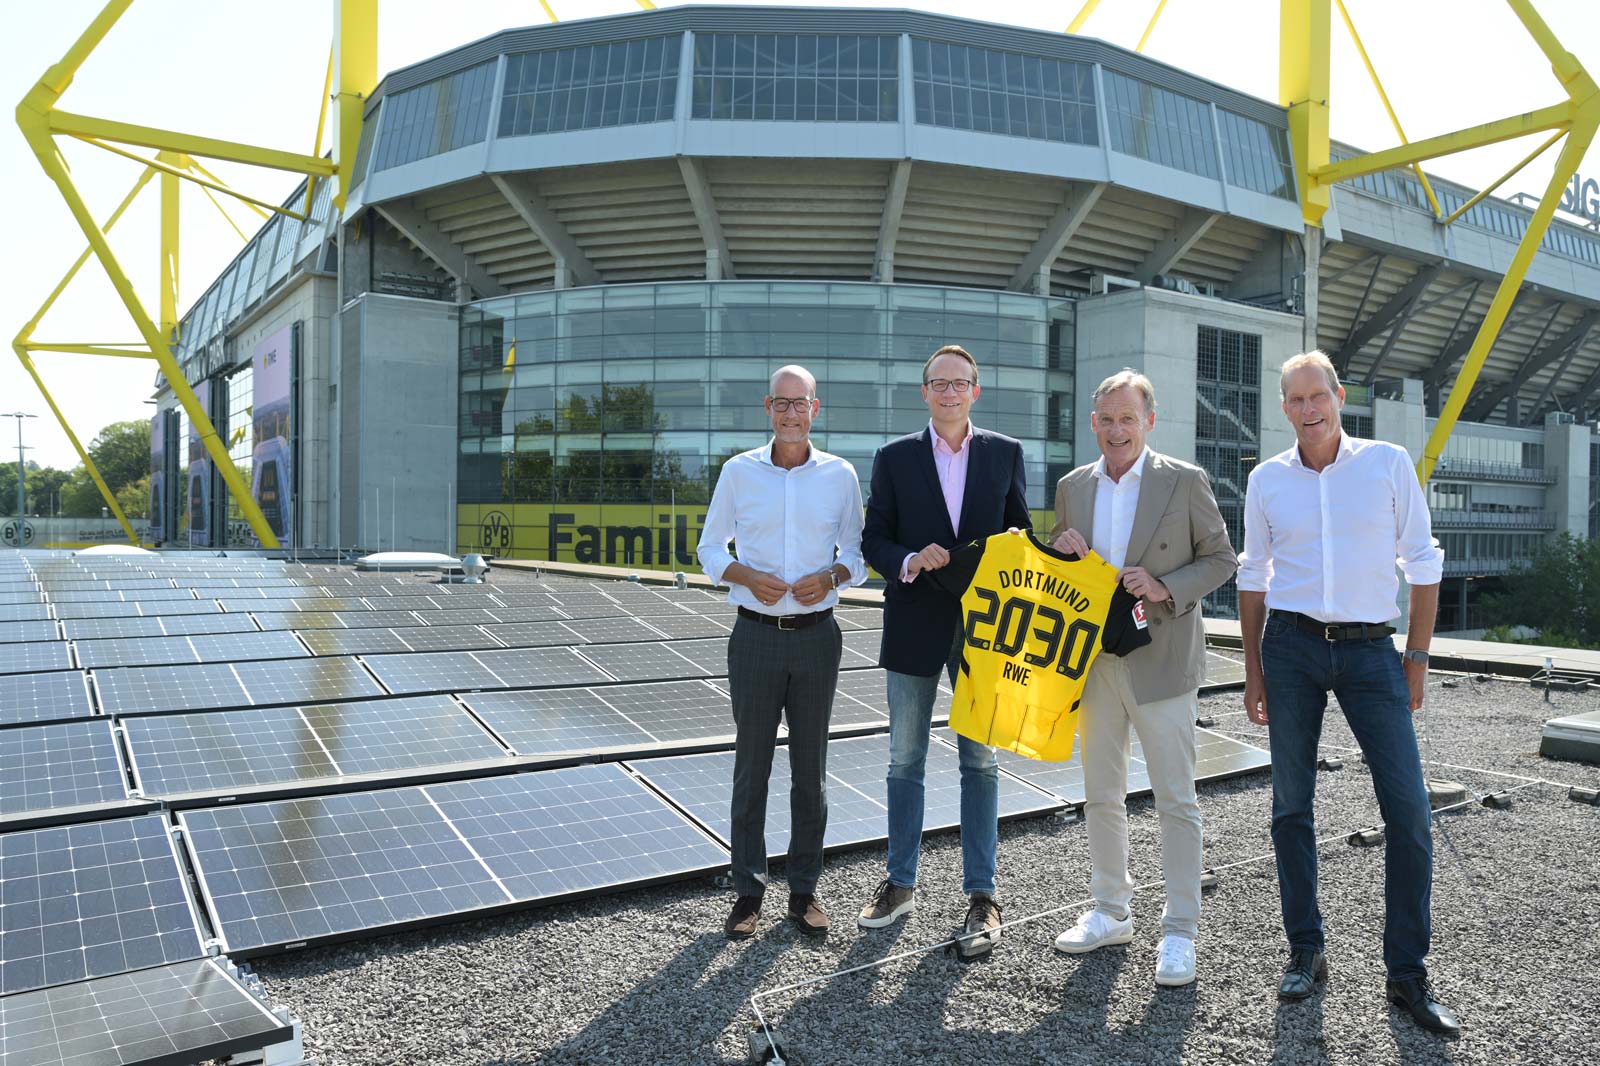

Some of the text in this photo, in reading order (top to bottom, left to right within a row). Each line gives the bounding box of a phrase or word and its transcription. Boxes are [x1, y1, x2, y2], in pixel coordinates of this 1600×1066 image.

[484, 515, 509, 547] BVB
[998, 569, 1090, 613] DORTMUND
[965, 586, 1100, 681] 2030
[1002, 661, 1032, 687] RWE
